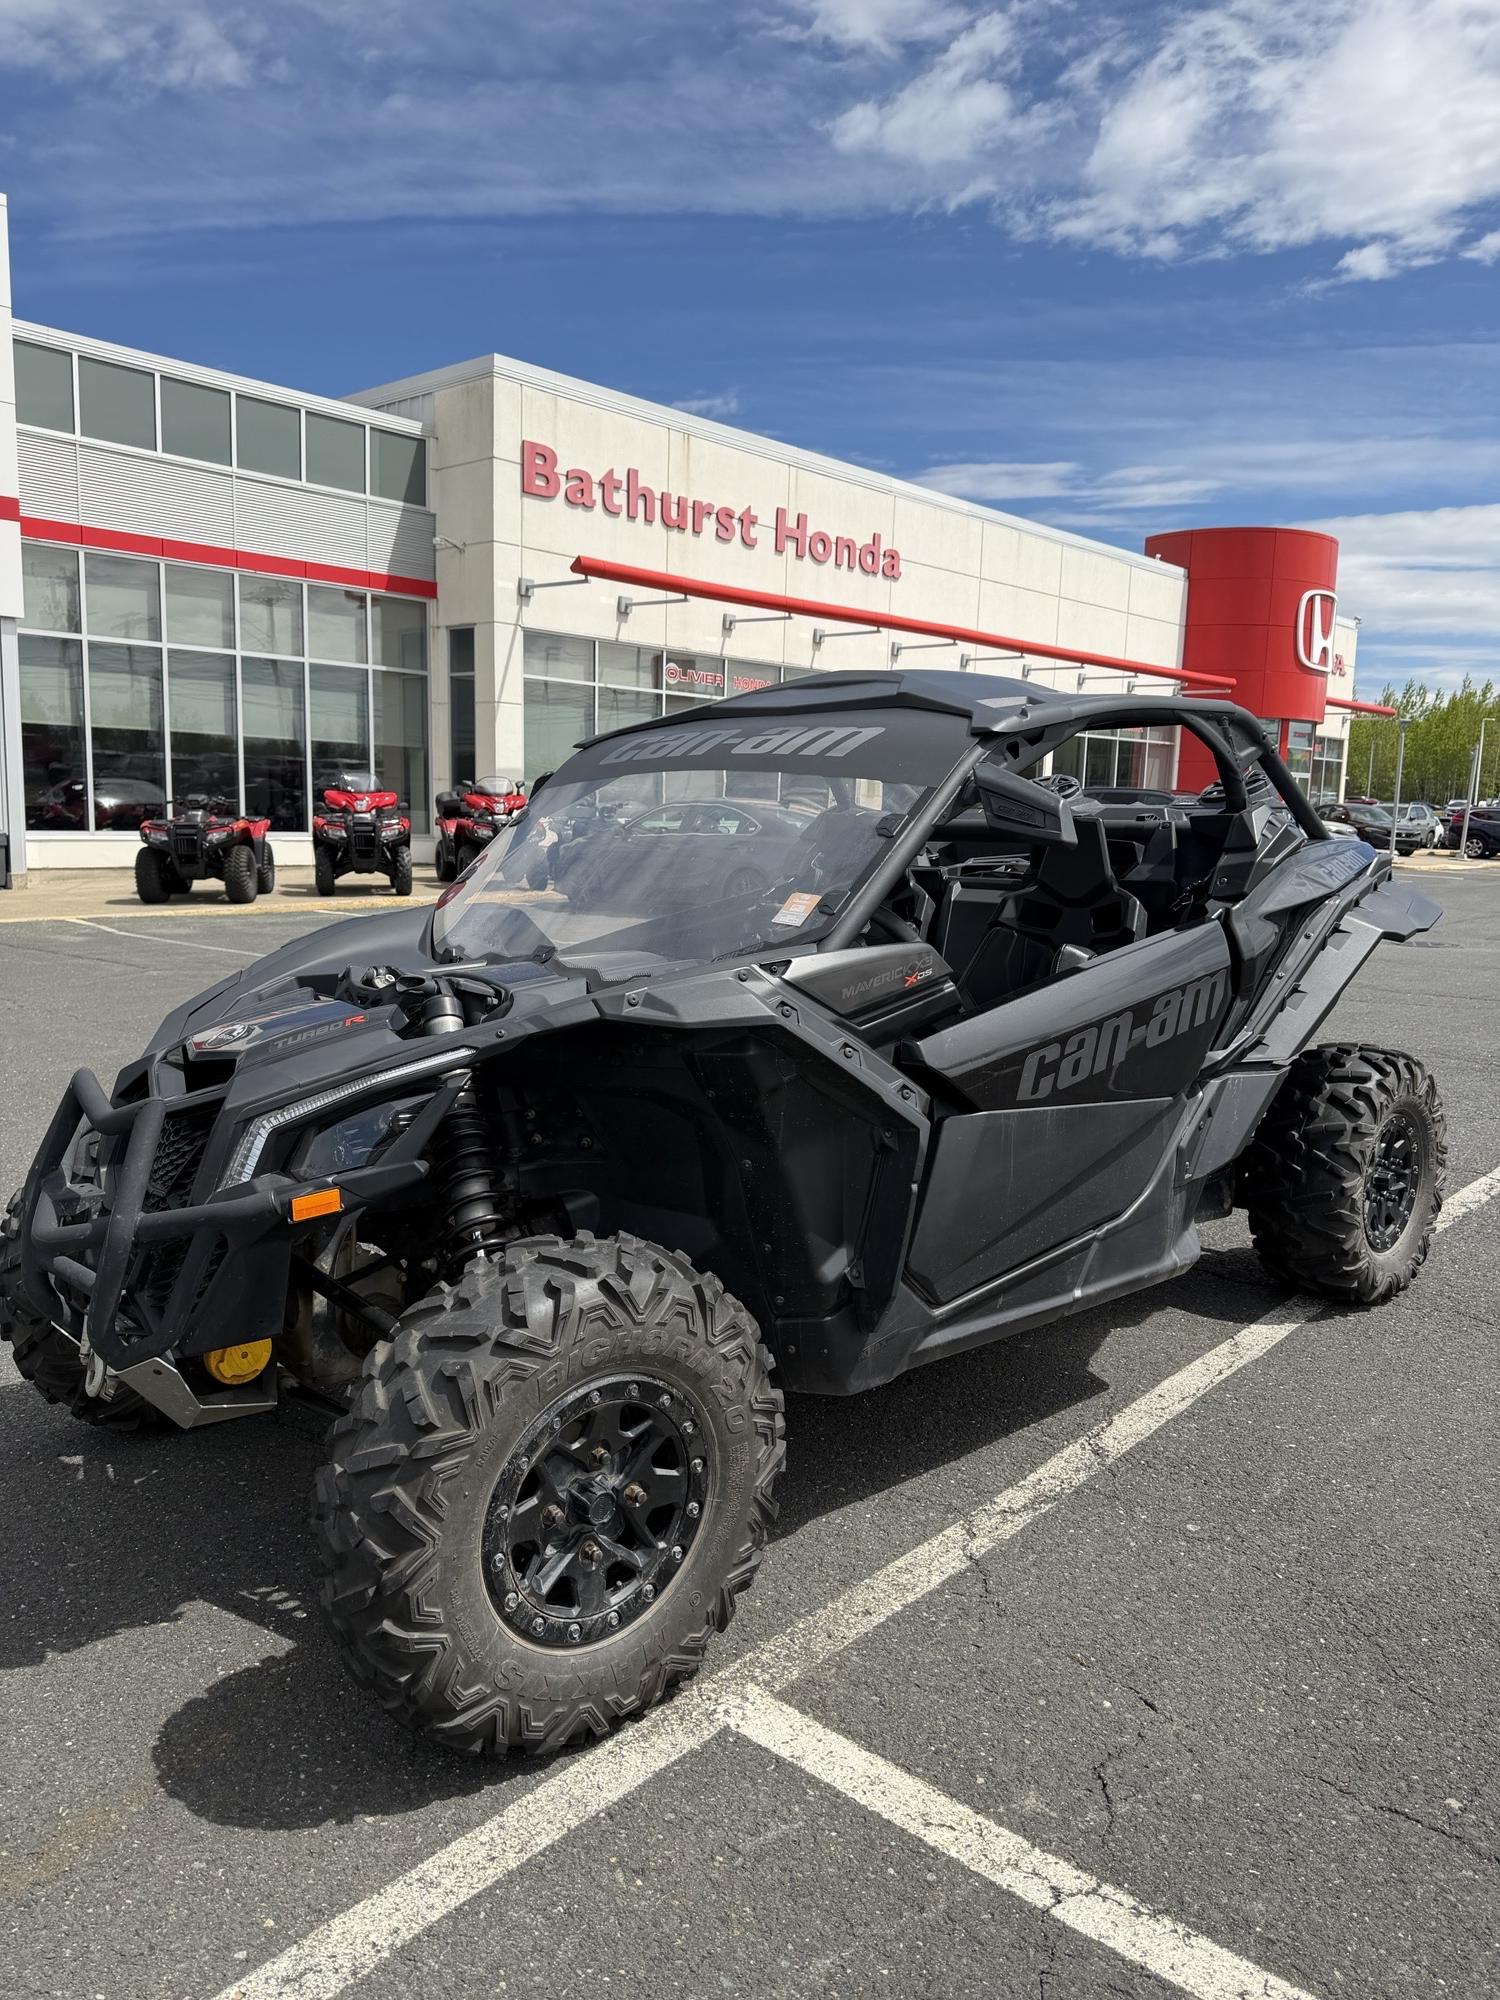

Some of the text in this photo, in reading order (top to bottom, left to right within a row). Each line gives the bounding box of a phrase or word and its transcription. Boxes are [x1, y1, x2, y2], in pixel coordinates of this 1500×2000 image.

[521, 439, 902, 580] Bathurst Honda
[666, 666, 724, 687] OLIVIER
[600, 726, 886, 765] can-am
[841, 962, 912, 999] MAVERICK
[1016, 969, 1230, 1101] can-am
[537, 1328, 718, 1403] BIGHORN
